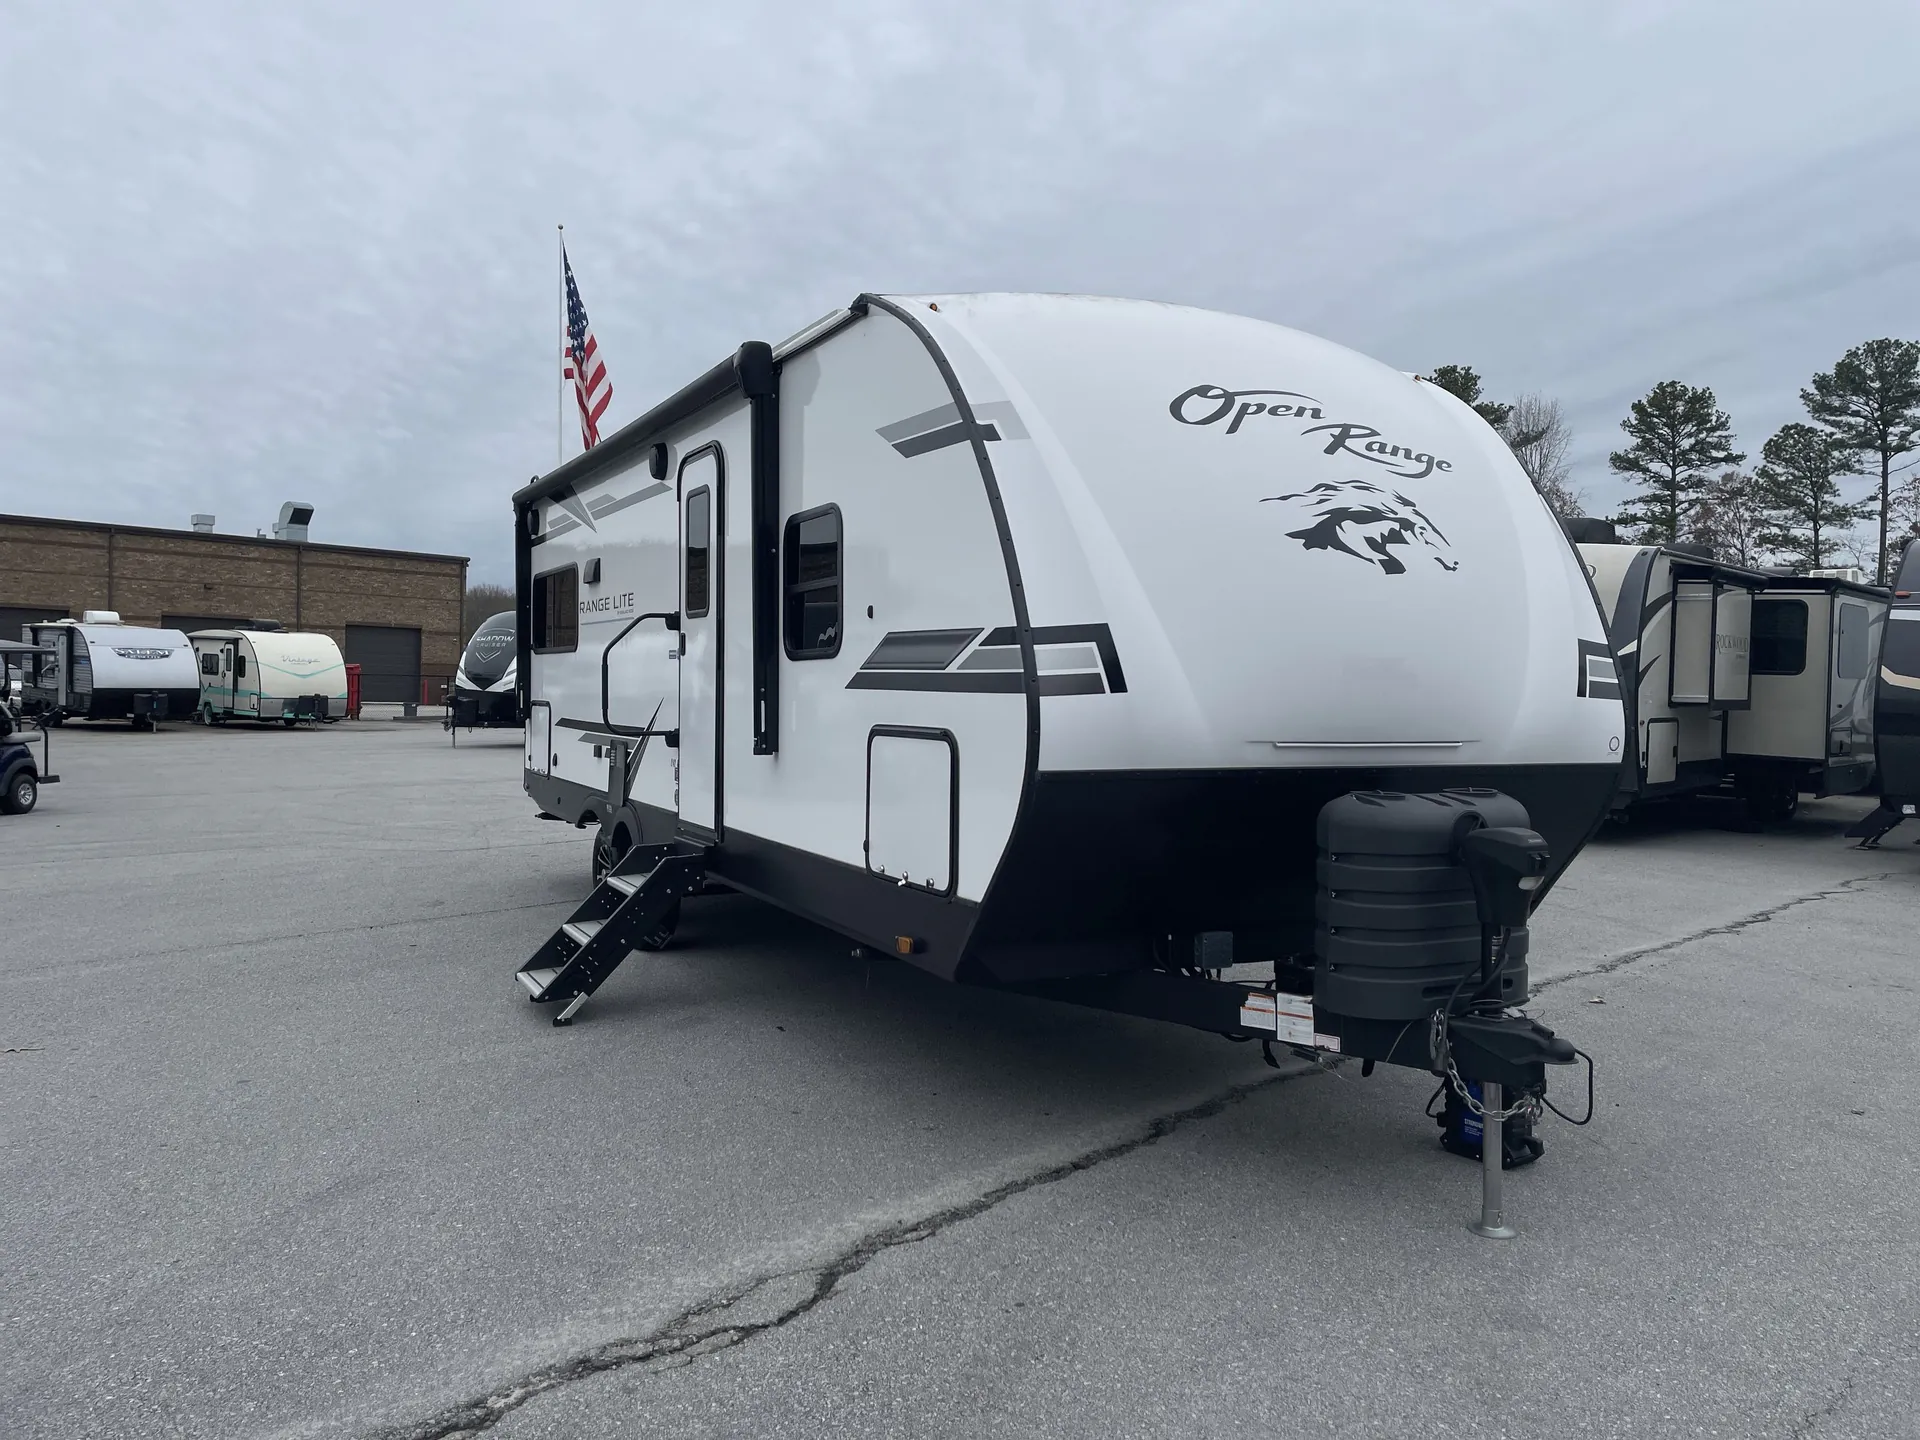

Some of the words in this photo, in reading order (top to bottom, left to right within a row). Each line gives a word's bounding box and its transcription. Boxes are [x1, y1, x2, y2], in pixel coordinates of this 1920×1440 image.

[1169, 384, 1326, 435] Open
[1300, 422, 1453, 479] Range
[580, 597, 610, 614] RANGE
[613, 592, 634, 609] LITE
